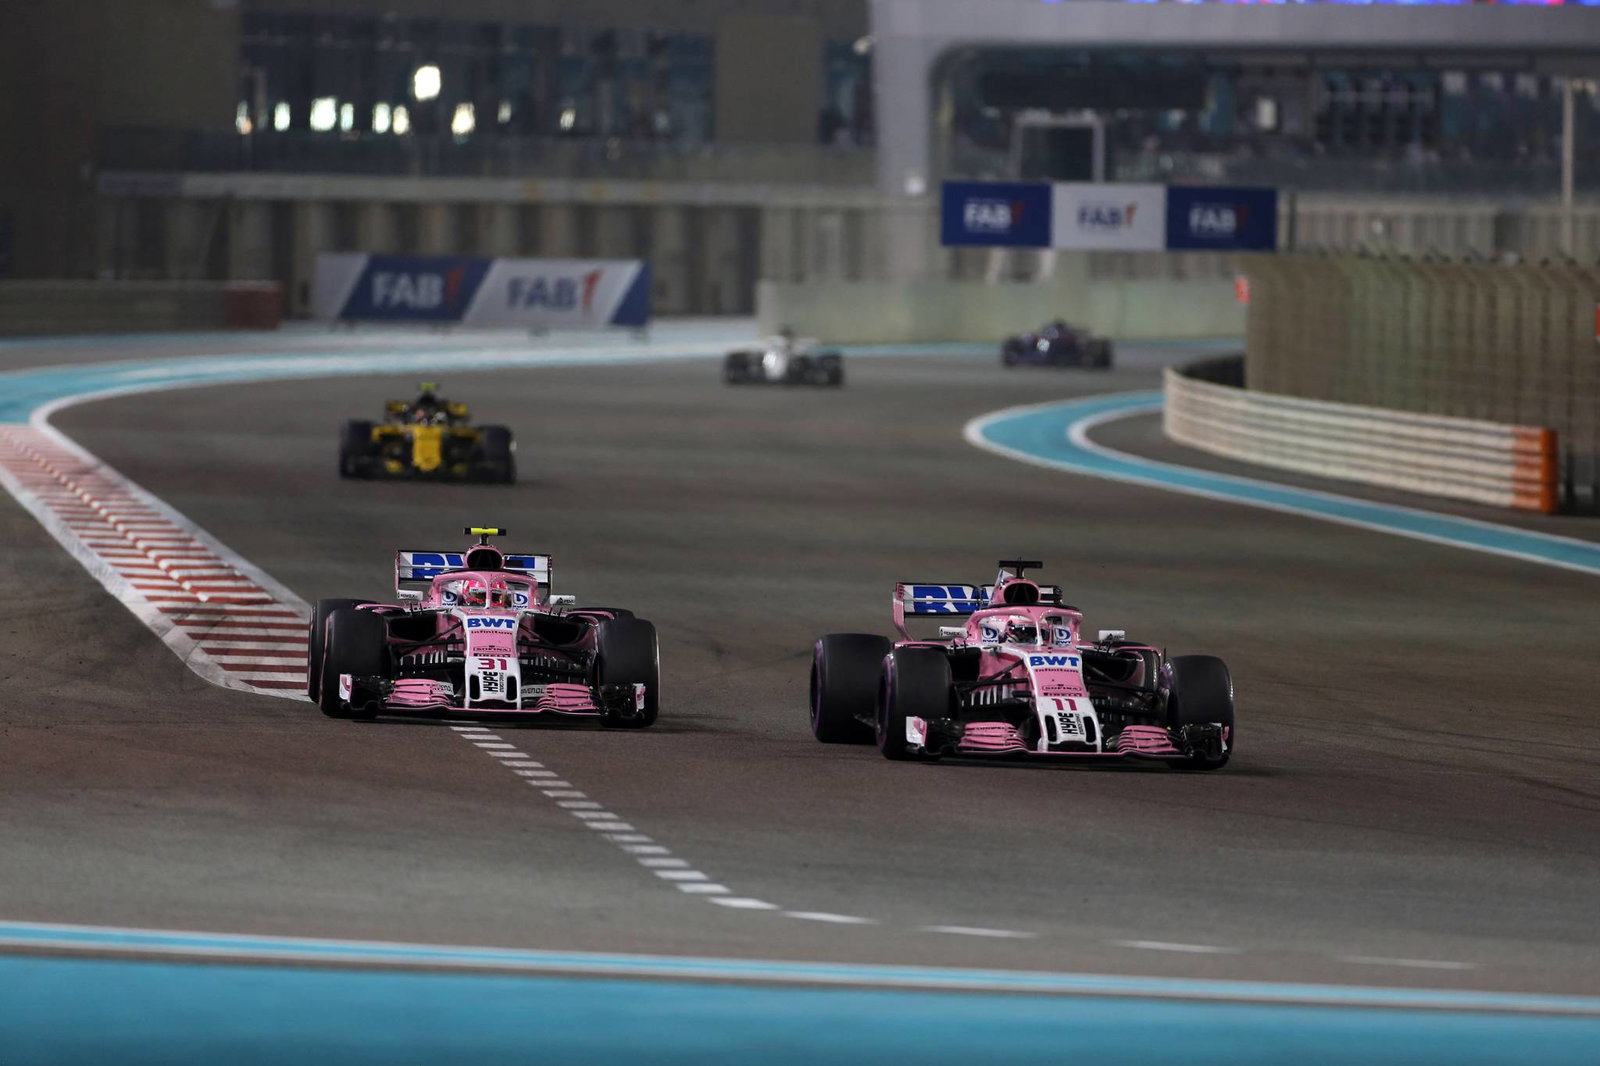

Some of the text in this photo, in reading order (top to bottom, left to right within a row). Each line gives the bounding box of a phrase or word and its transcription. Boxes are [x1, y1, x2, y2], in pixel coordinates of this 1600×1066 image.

[467, 617, 516, 629] BWT
[477, 657, 507, 671] 31
[1030, 655, 1079, 667] BWT
[482, 671, 499, 692] HYPE
[1051, 698, 1077, 711] 11
[1057, 712, 1079, 735] HYPE
